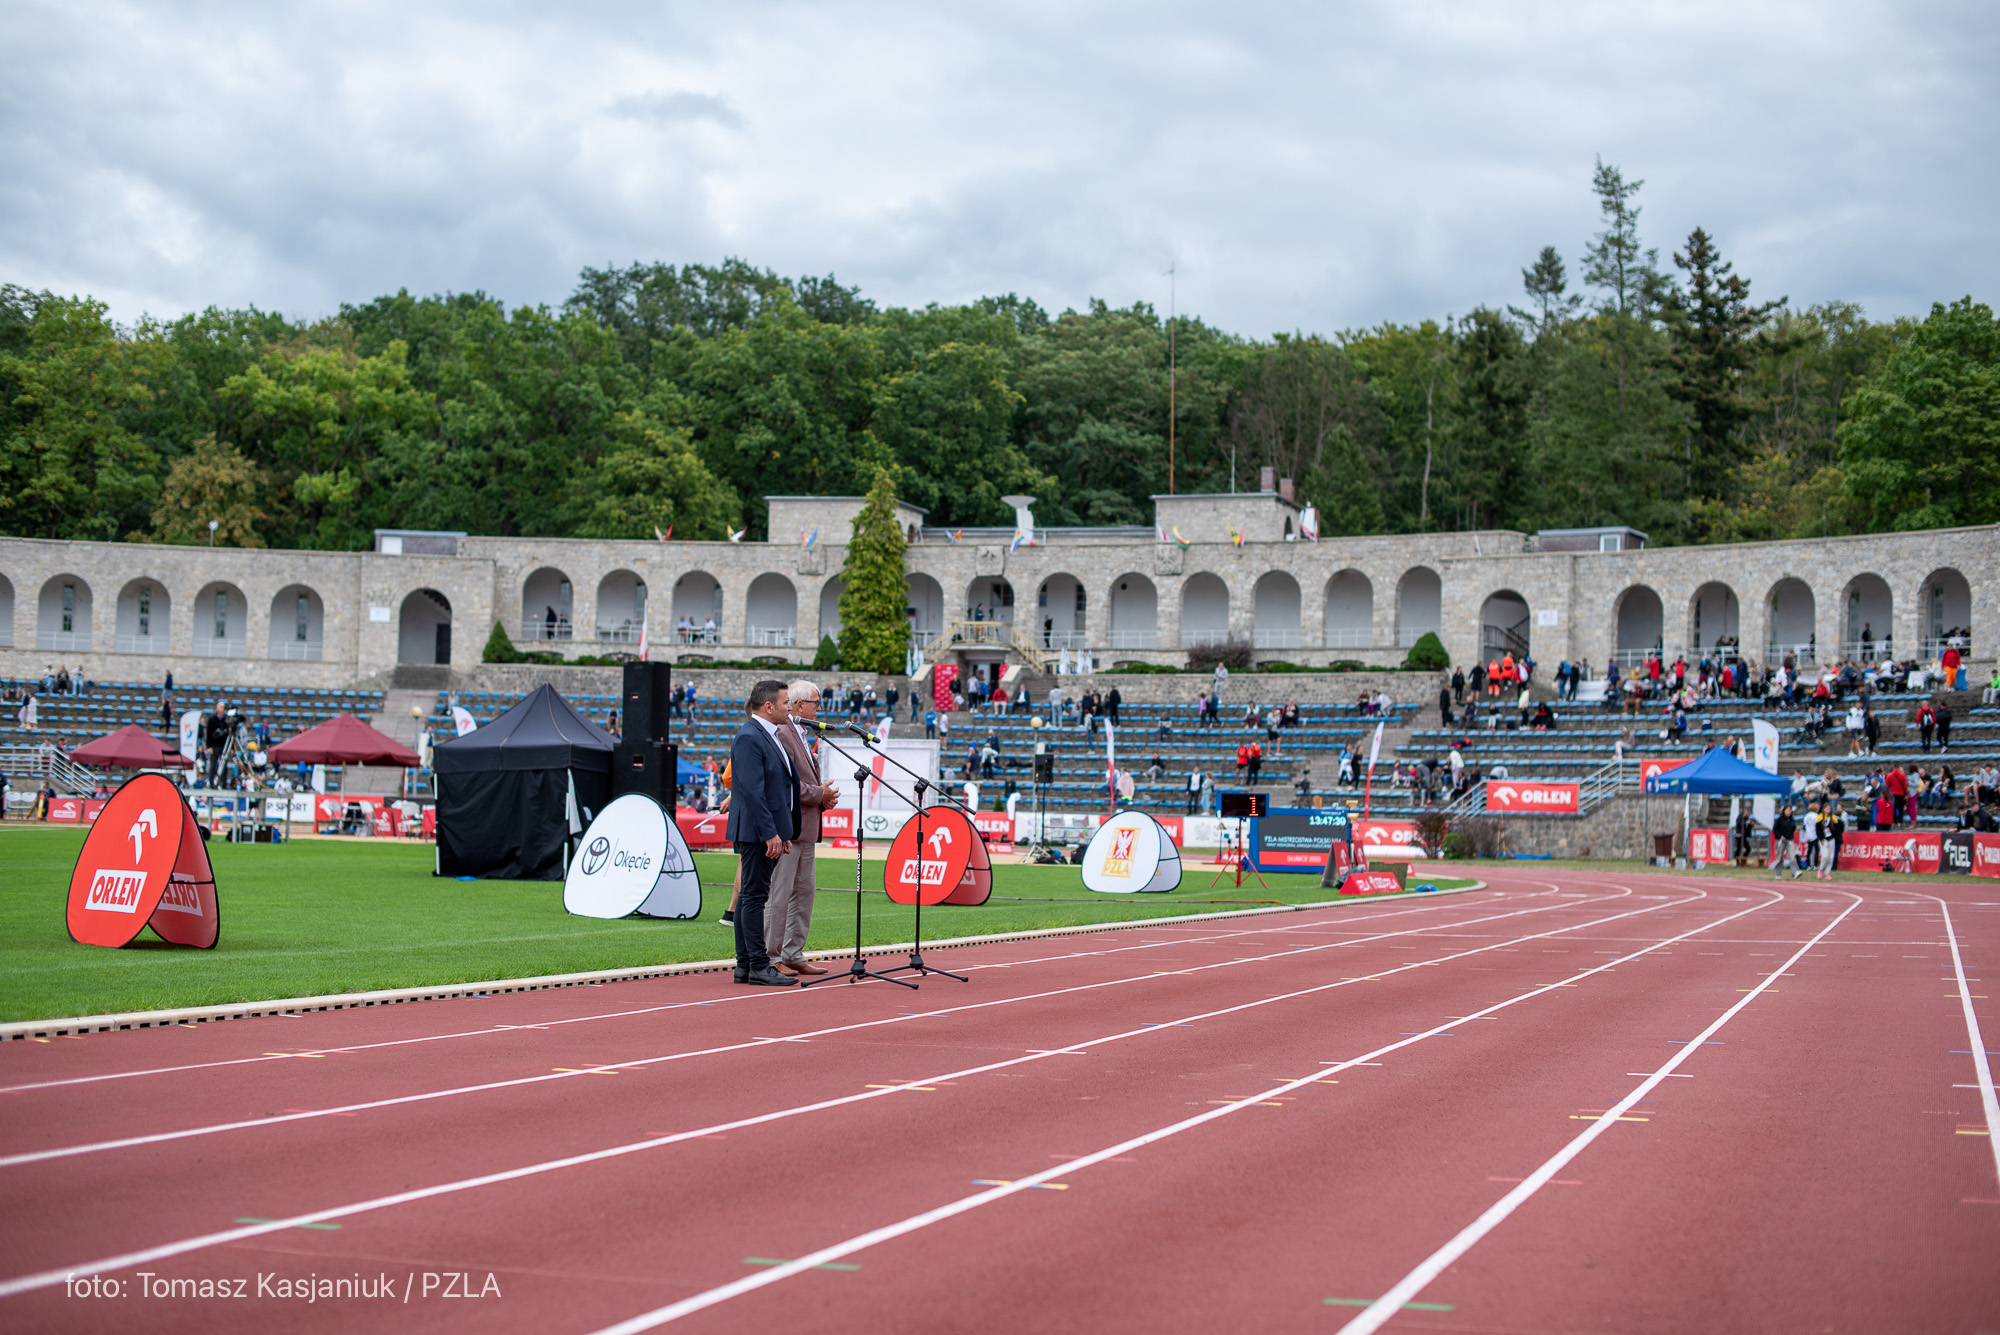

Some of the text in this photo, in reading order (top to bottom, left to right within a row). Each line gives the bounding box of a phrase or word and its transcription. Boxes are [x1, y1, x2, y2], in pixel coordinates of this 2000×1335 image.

[1521, 789, 1571, 804] ORLEN
[823, 816, 848, 828] LEN
[976, 819, 1010, 832] RLEN
[1309, 815, 1346, 826] 13:47:39
[613, 851, 651, 872] Okęcie
[1949, 845, 1972, 868] FUEL
[1103, 860, 1130, 875] PZLA
[92, 875, 142, 907] ORLEN
